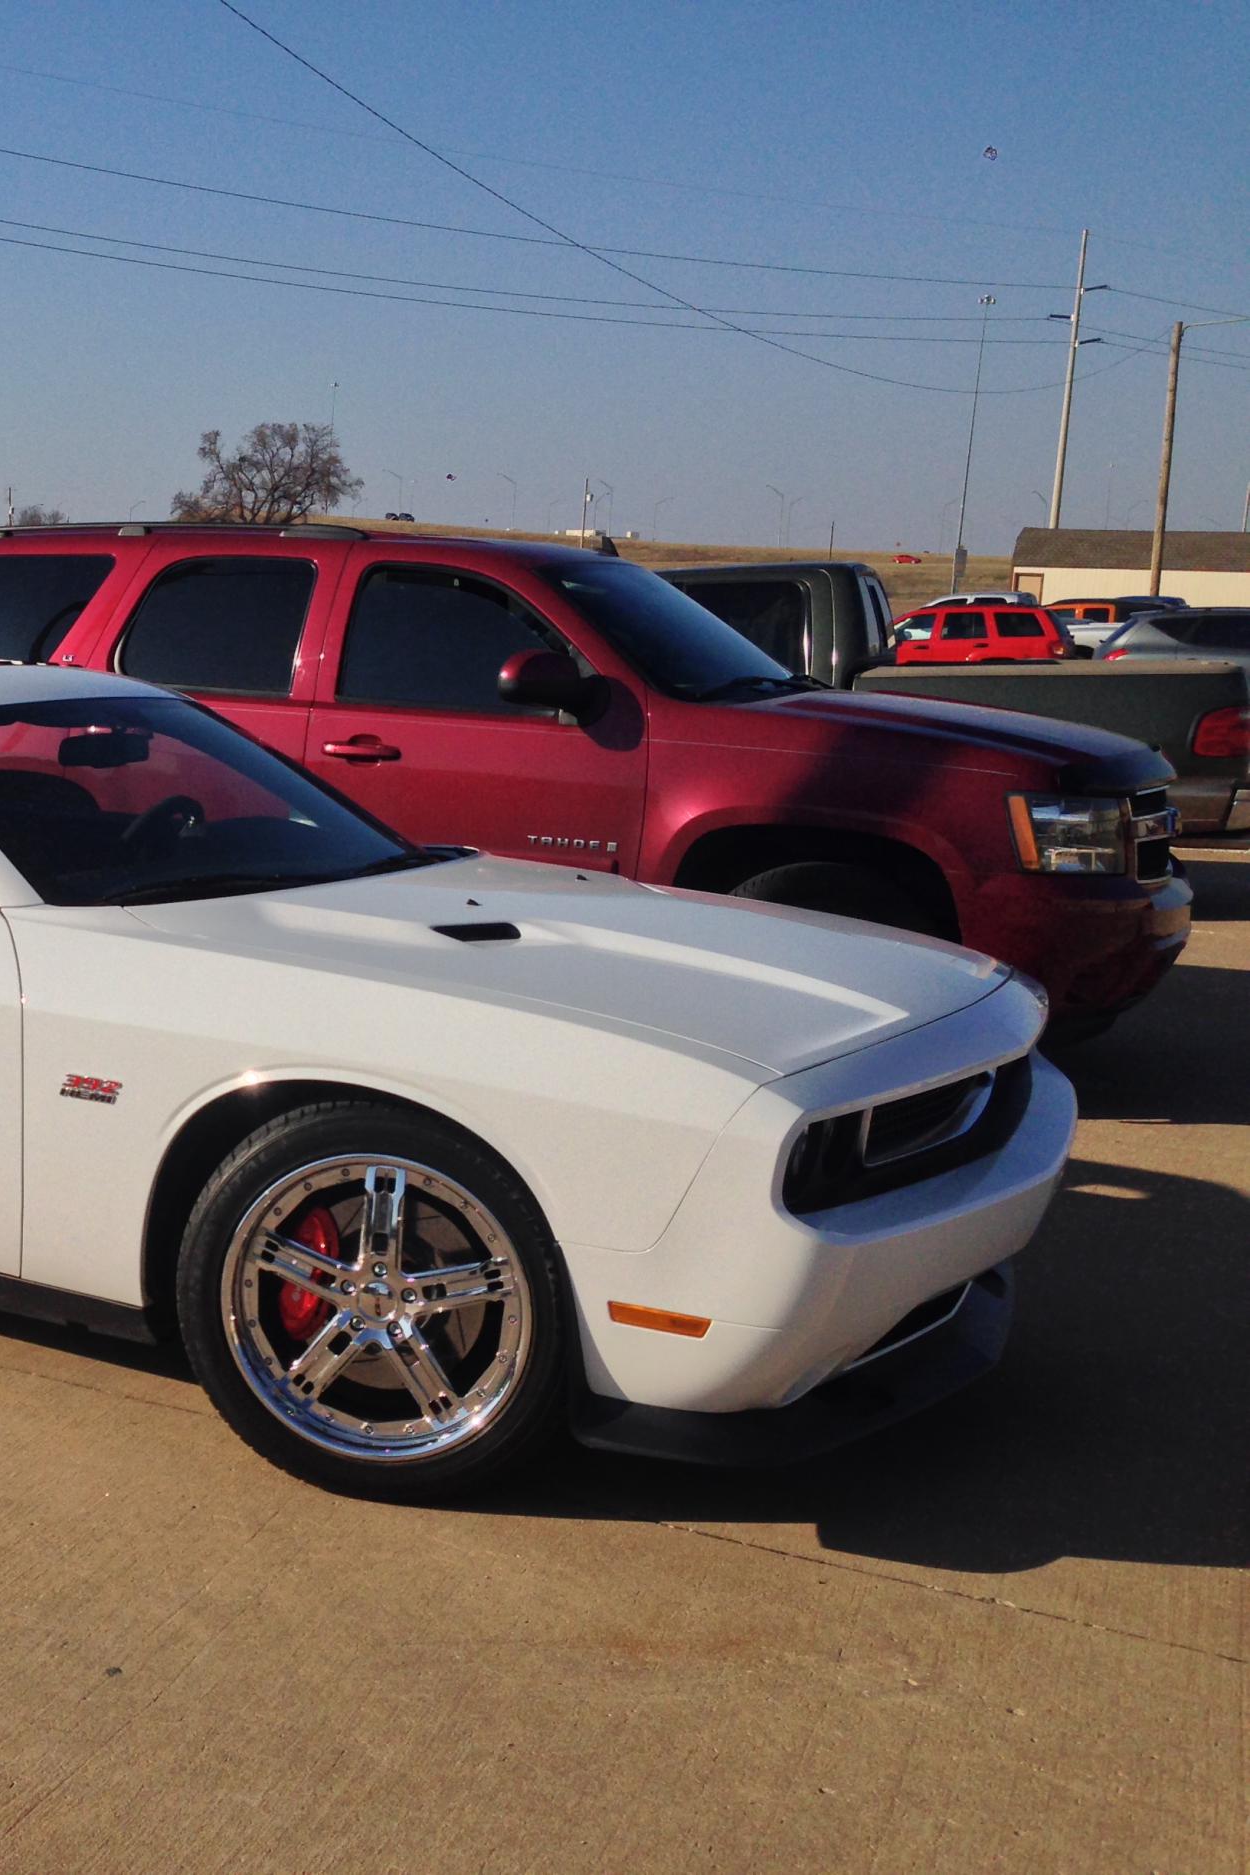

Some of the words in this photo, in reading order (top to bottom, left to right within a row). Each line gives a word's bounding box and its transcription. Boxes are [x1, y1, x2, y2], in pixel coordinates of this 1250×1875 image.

[527, 835, 601, 850] TAHOE
[62, 1073, 123, 1096] 392
[59, 1087, 117, 1105] HEMI
